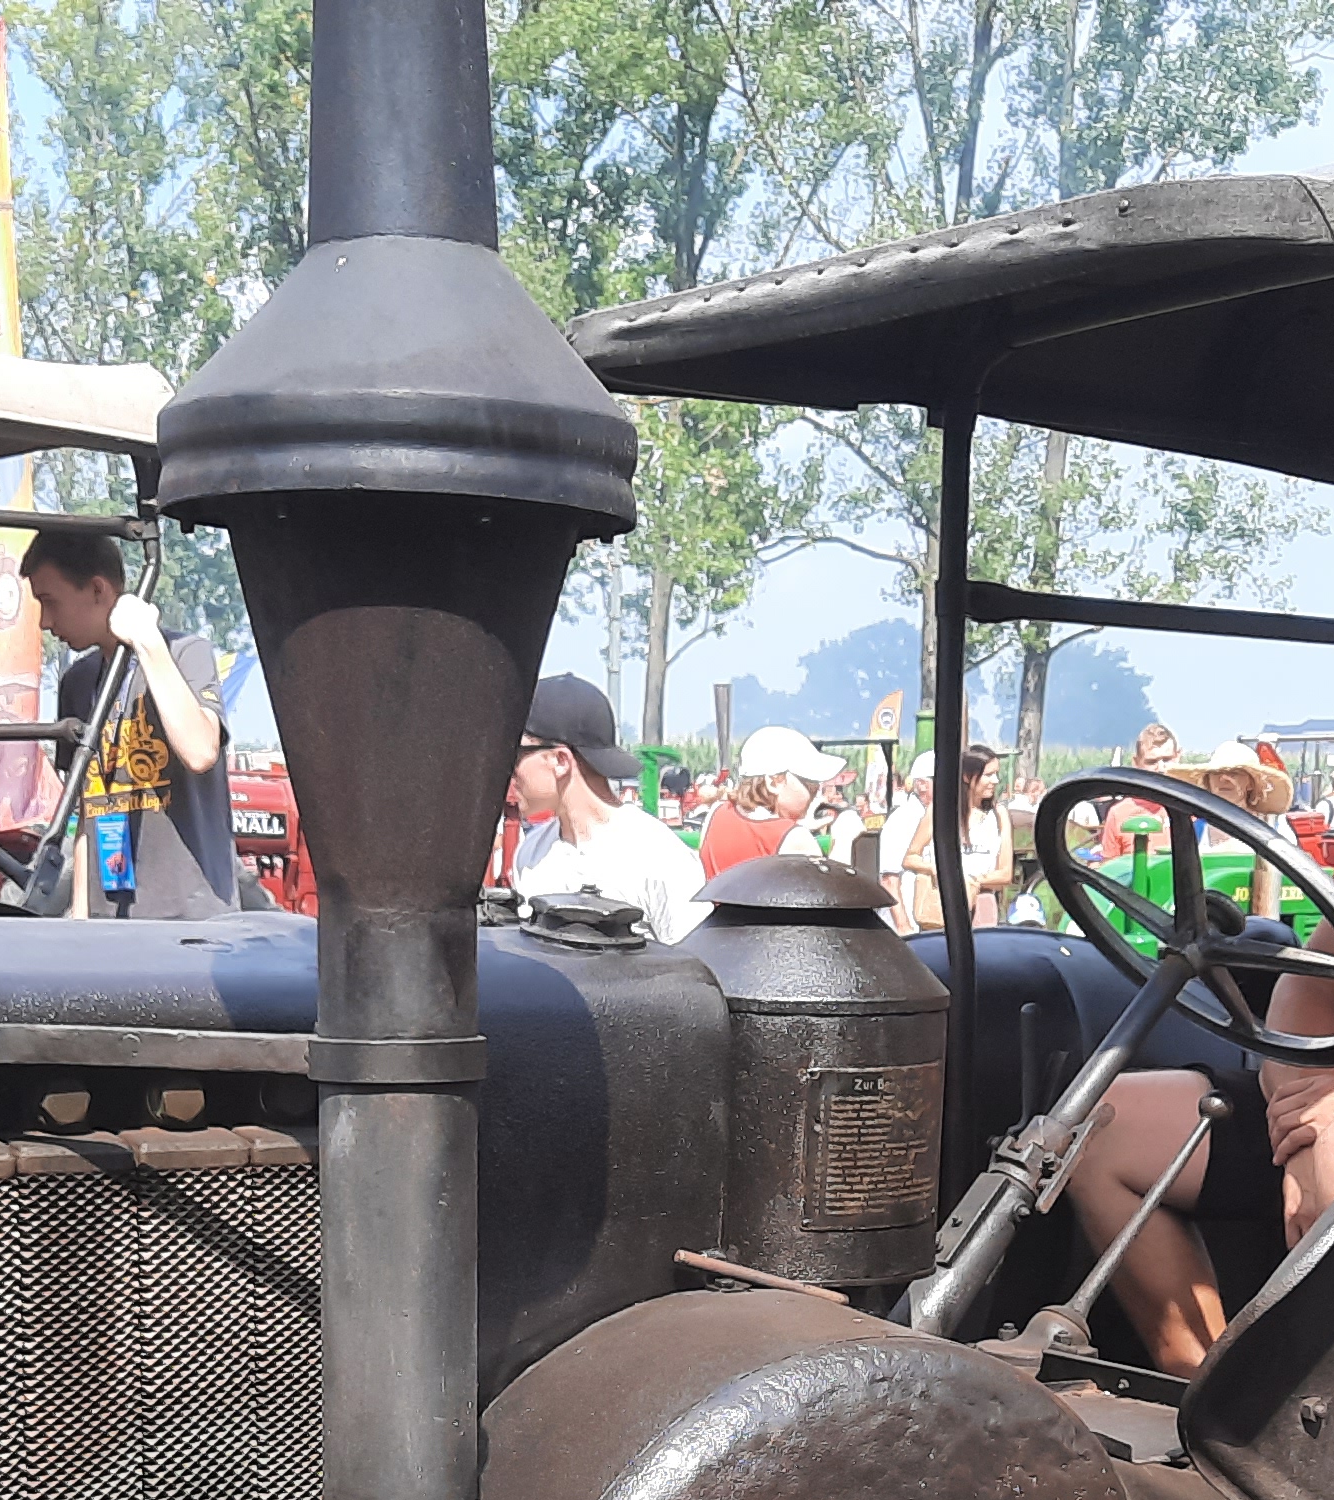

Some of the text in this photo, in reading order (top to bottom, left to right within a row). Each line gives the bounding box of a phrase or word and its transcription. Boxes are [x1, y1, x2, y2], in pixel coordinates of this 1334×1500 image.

[231, 815, 286, 835] MALL
[1232, 885, 1306, 902] JO ERE
[853, 1078, 875, 1091] Zur
